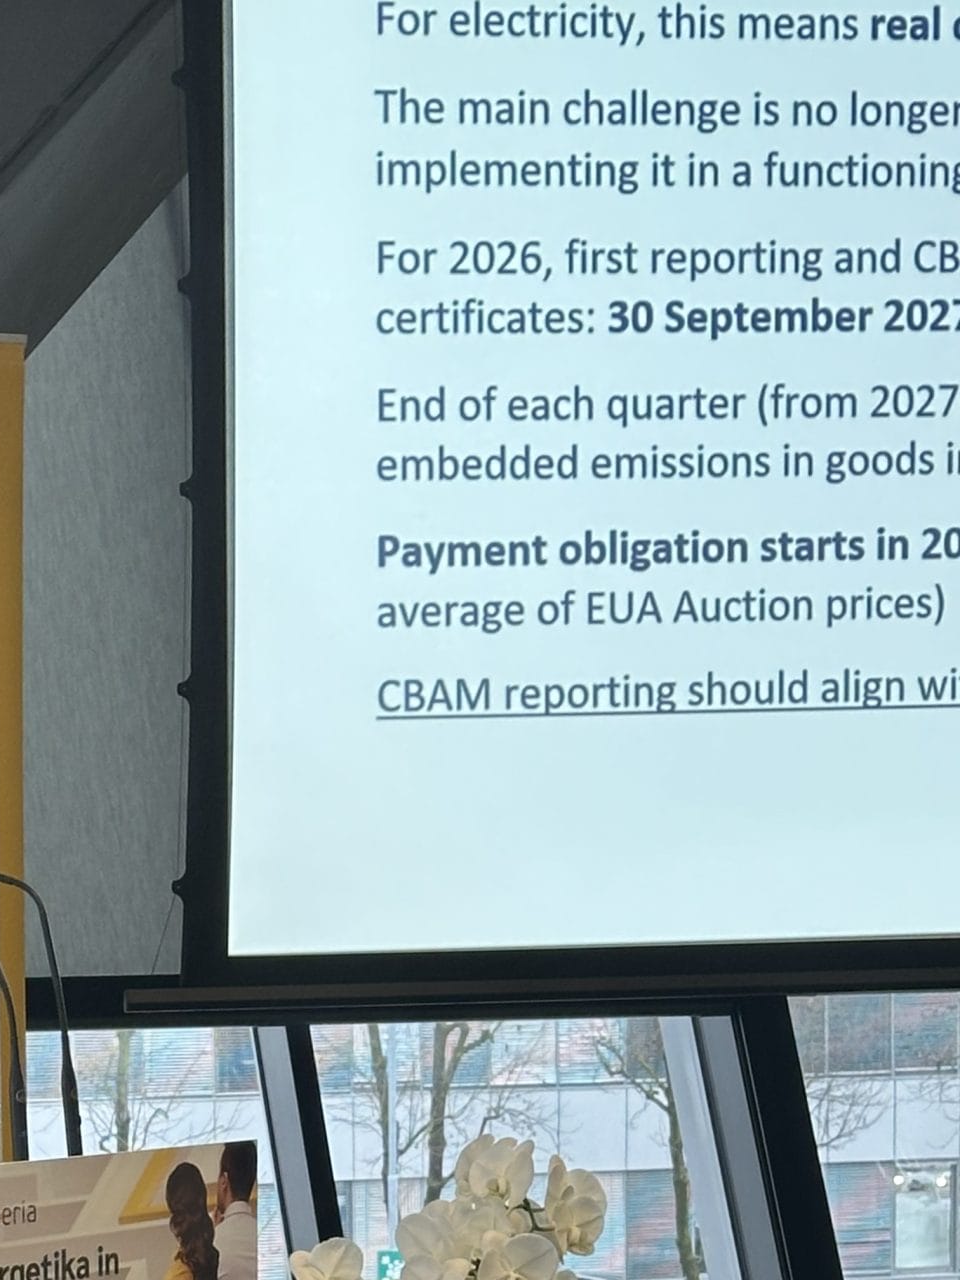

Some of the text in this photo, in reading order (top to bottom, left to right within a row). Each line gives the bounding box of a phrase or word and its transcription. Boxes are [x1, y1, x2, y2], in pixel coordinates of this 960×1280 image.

[377, 1, 437, 36] For
[450, 0, 645, 46] electricity,
[658, 2, 725, 39] this
[739, 14, 858, 41] means
[871, 5, 940, 41] real
[374, 87, 444, 125] The
[459, 90, 549, 125] main
[563, 89, 740, 134] challenge
[754, 91, 779, 126] is
[793, 101, 837, 126] no
[377, 150, 639, 195] implementing
[652, 152, 675, 187] it
[689, 152, 718, 187] in
[733, 161, 751, 187] a
[378, 241, 437, 275] For
[450, 241, 552, 282] 2026,
[565, 238, 638, 274] first
[651, 240, 823, 282] reporting
[835, 238, 901, 274] and
[376, 298, 594, 334] certificates:
[608, 301, 653, 333] 30
[665, 297, 873, 341] September
[378, 383, 959, 428] End of each quarter (from 2027
[377, 440, 960, 484] embedded emissions in goods i
[378, 534, 547, 575] Payment
[559, 529, 748, 572] obligation
[761, 531, 865, 562] starts
[877, 527, 908, 560] in
[378, 584, 944, 634] average of EUA Auction prices)
[378, 678, 490, 712] CBAM
[505, 674, 676, 714] reporting
[688, 669, 808, 707] should
[821, 668, 905, 709] align
[97, 1246, 120, 1277] in
